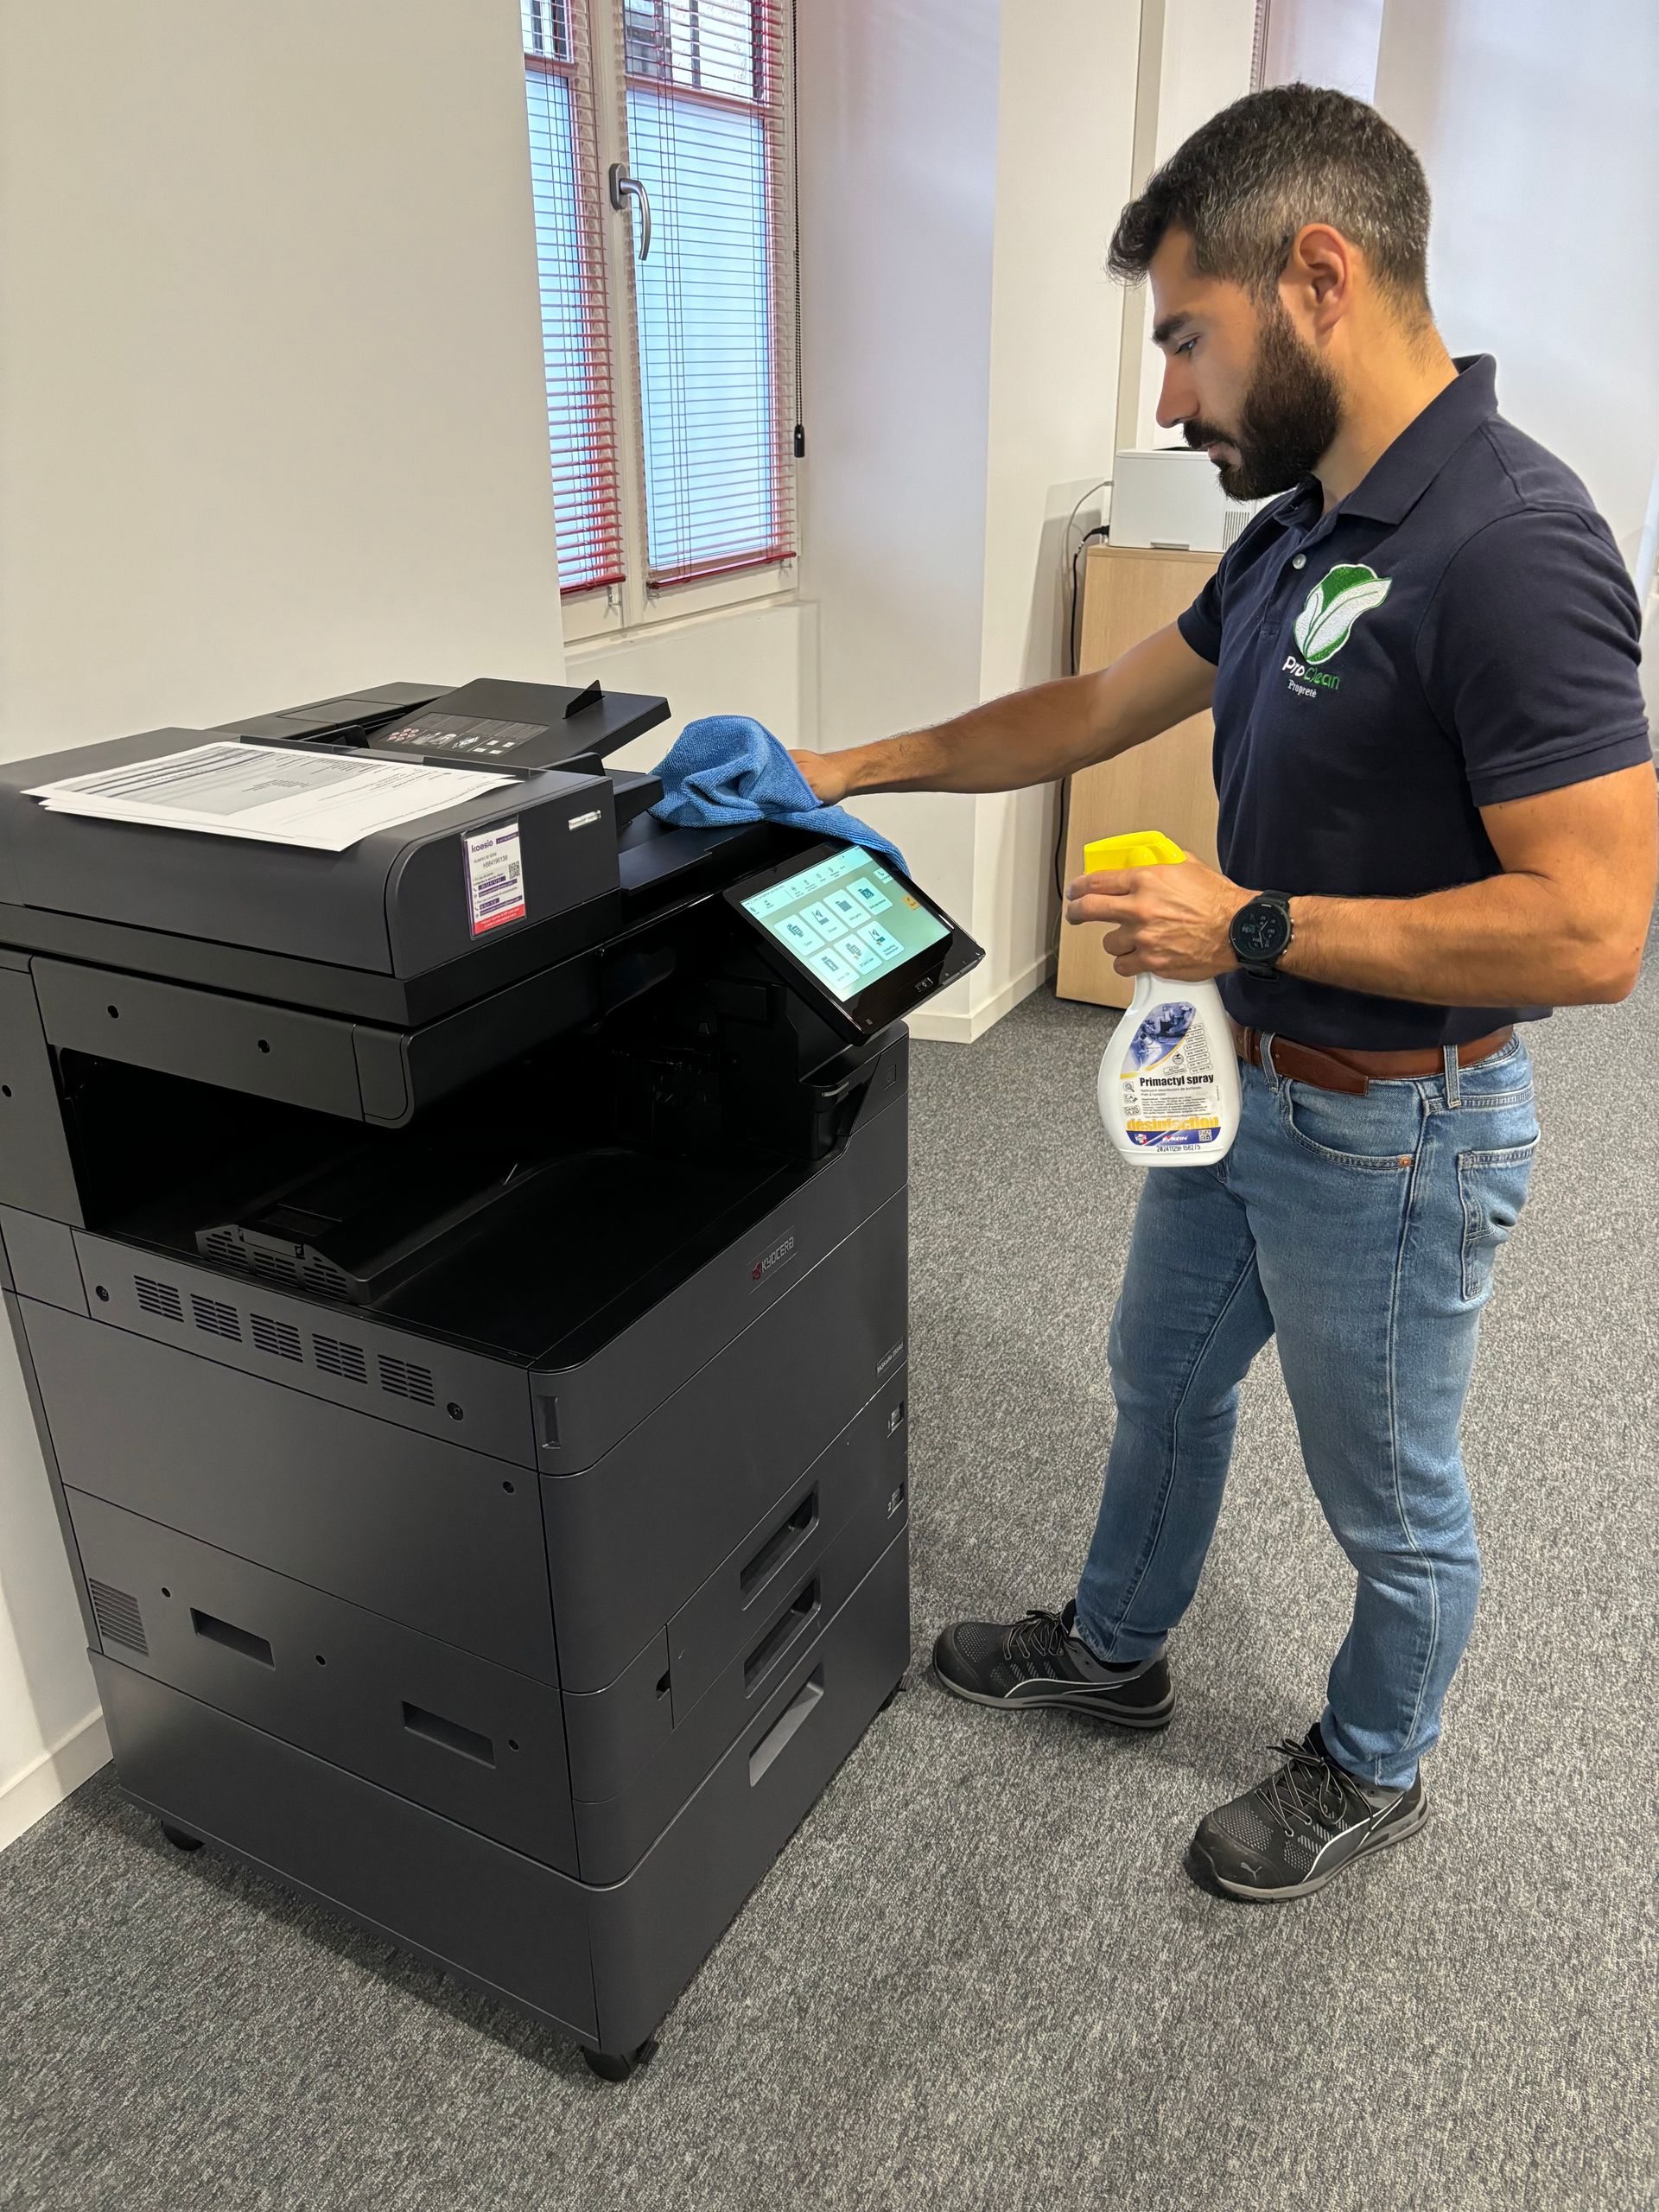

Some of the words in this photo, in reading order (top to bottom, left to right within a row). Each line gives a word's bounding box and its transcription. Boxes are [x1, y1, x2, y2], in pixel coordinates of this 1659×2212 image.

[1282, 656, 1339, 690] ProClean
[1287, 679, 1317, 697] Propreté
[472, 840, 493, 853] koesio
[1140, 1076, 1185, 1086] Primactyl
[1186, 1074, 1214, 1084] spray
[1127, 1116, 1219, 1130] désinfection
[761, 1236, 794, 1273] KYOCERA
